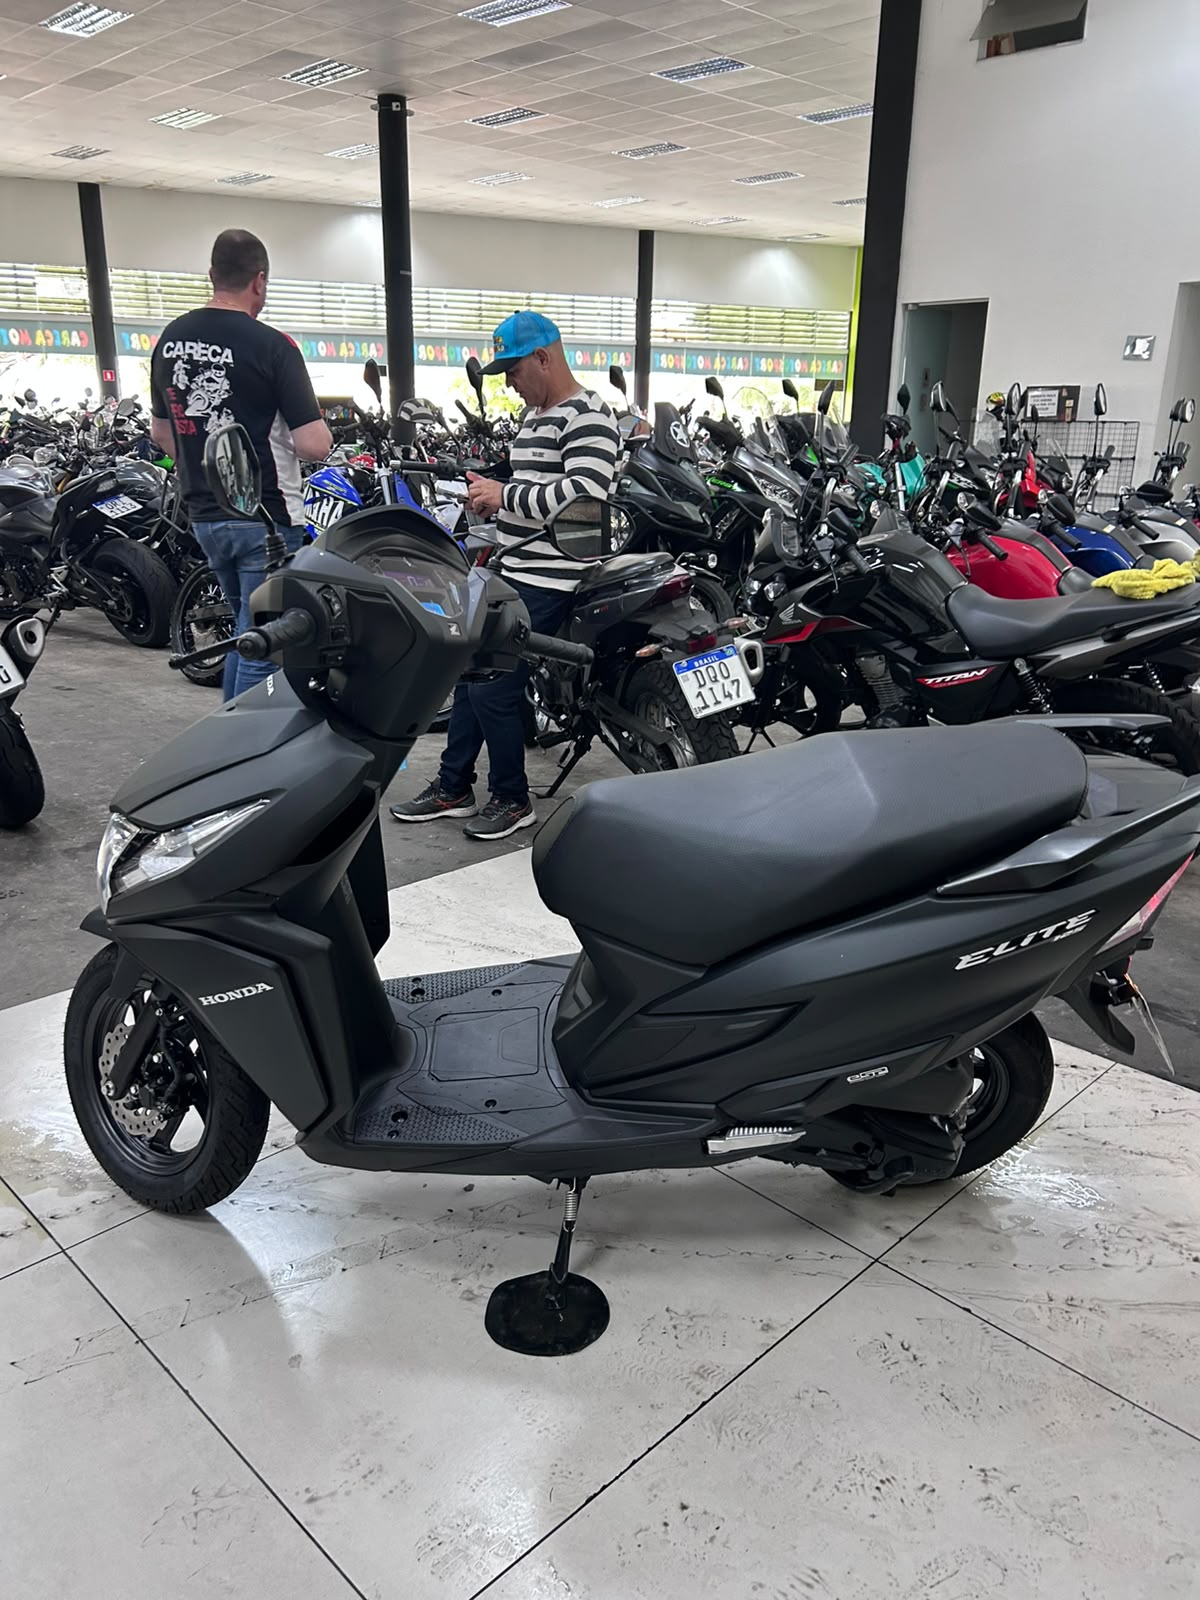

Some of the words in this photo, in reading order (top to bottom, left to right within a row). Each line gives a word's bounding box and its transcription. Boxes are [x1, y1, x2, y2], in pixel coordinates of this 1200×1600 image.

[162, 340, 234, 367] CARECA
[694, 655, 720, 667] BRASIL
[693, 661, 731, 688] DQO
[924, 668, 988, 685] TITAN
[954, 909, 1096, 970] ELITE
[198, 982, 274, 1006] HONDA
